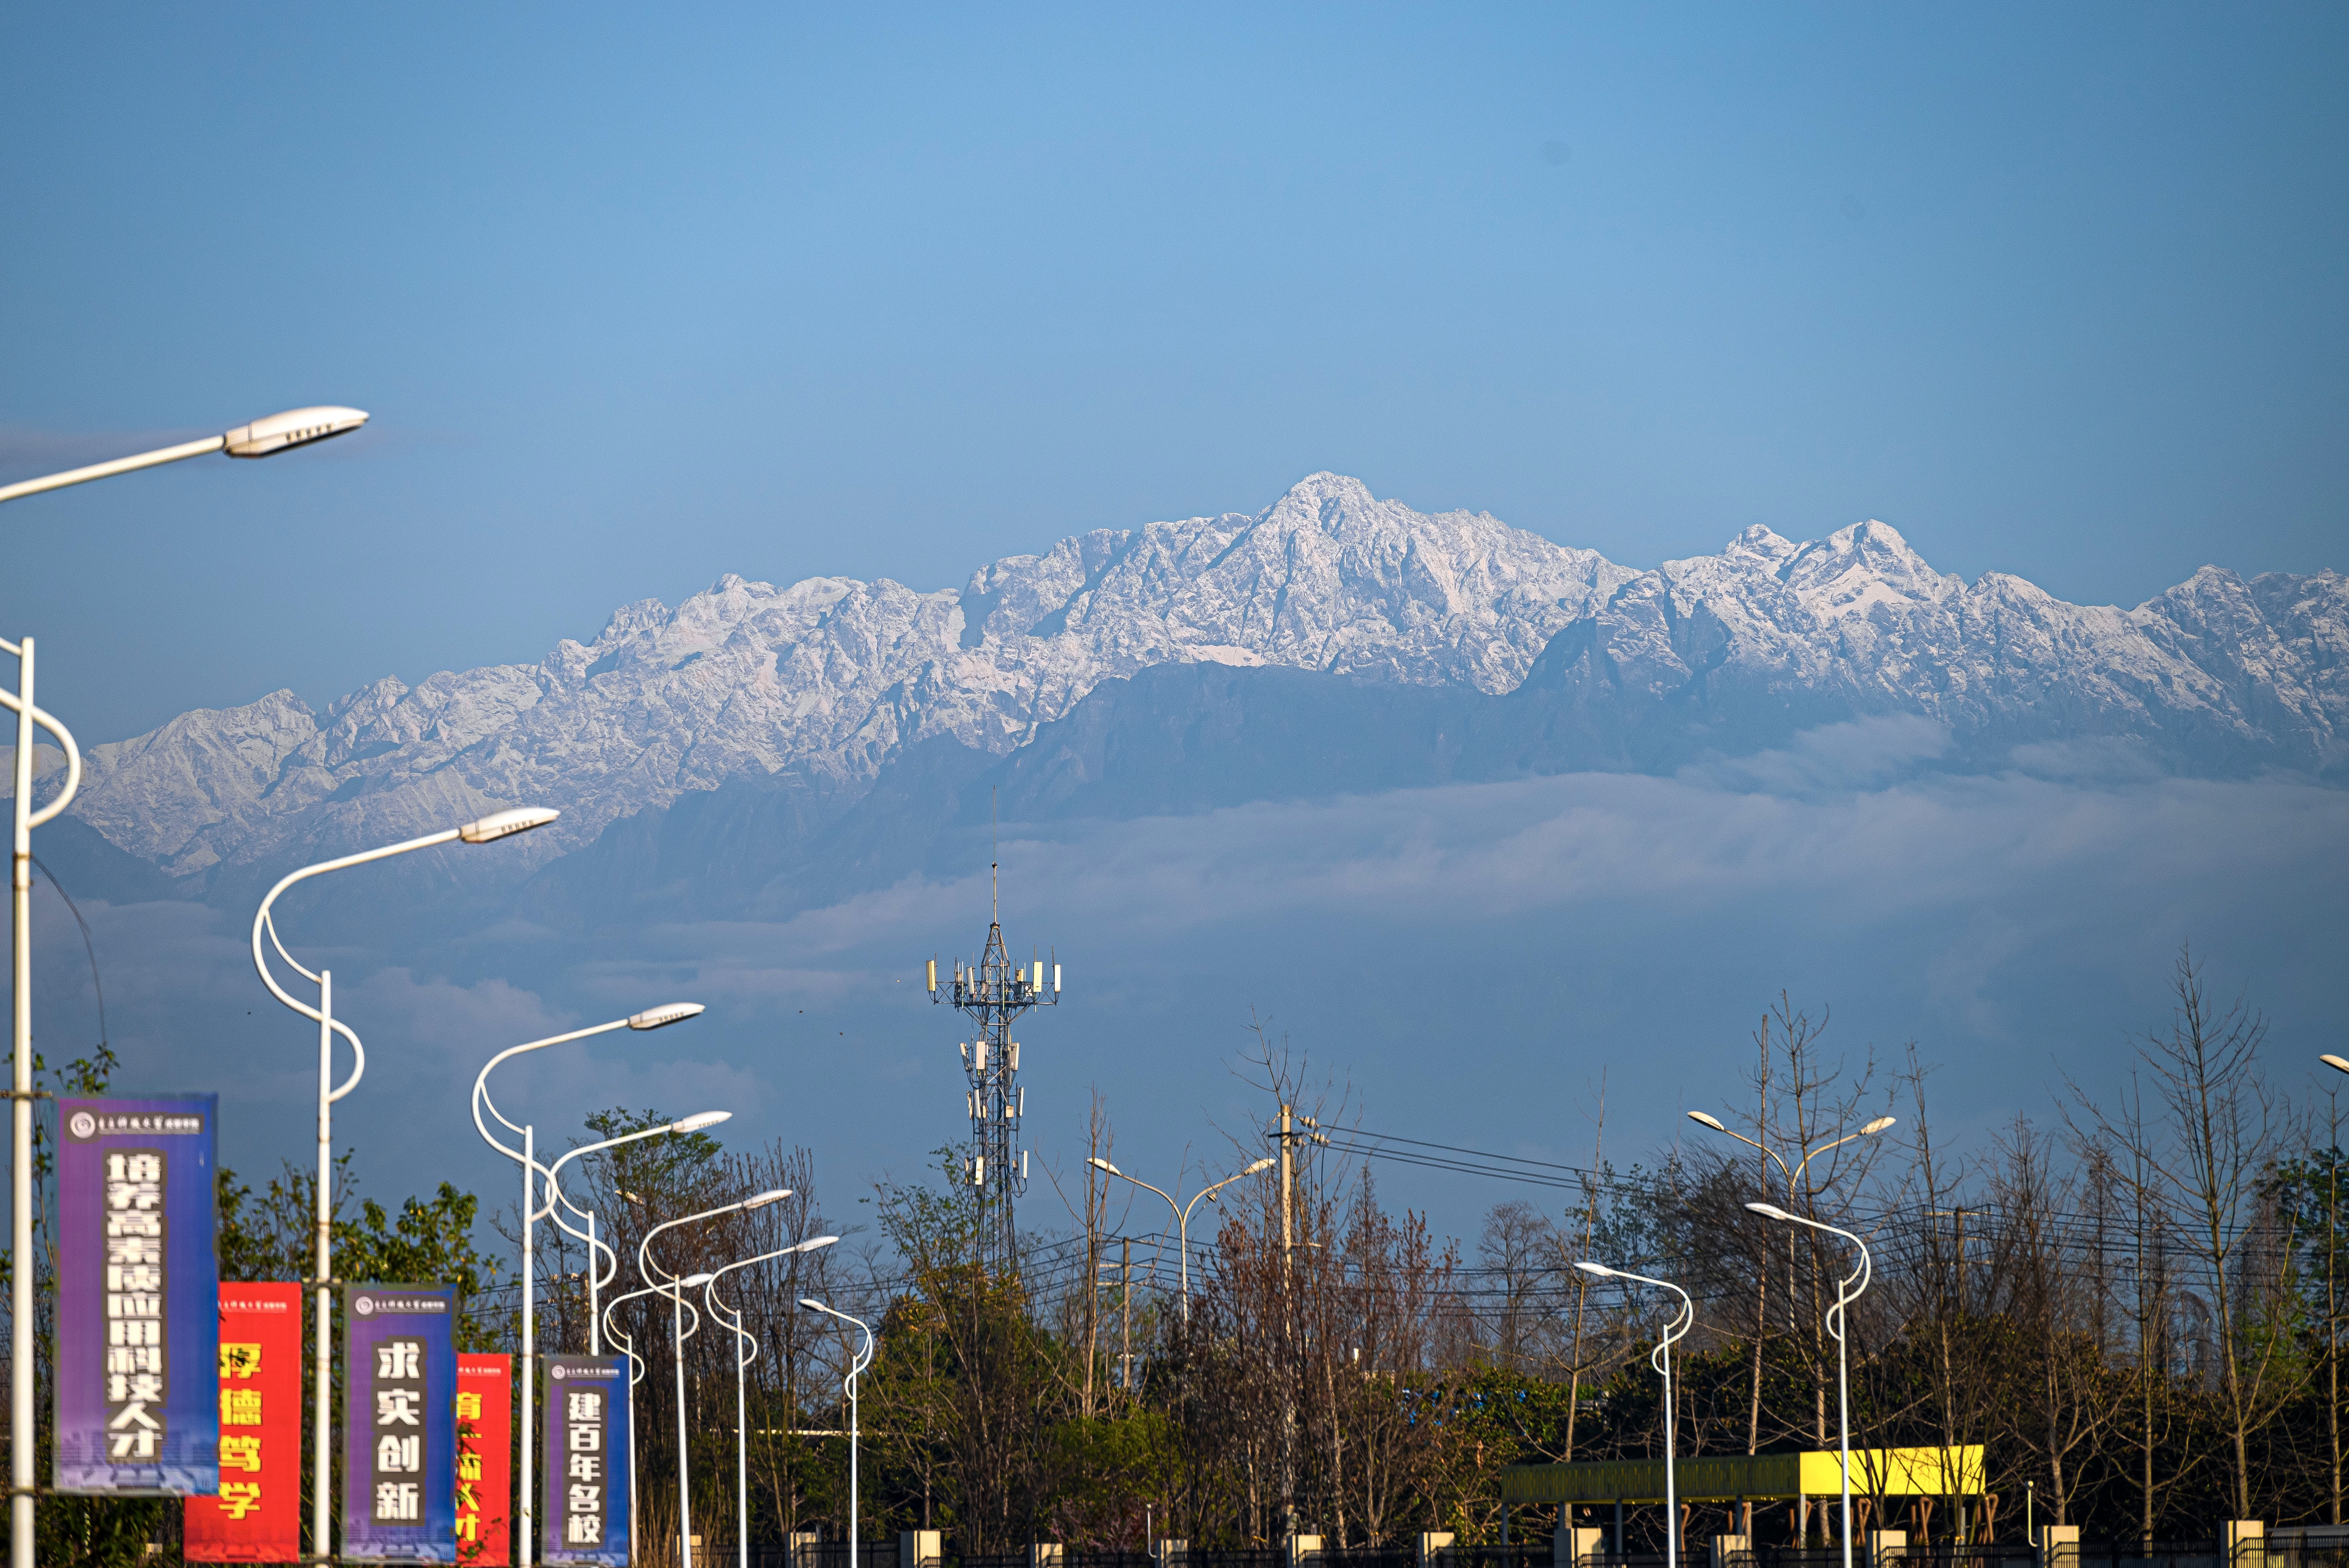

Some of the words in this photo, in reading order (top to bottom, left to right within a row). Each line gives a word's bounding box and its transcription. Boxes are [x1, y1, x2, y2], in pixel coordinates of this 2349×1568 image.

[107, 1153, 163, 1458] 培养高素质应用科技人才
[218, 1342, 262, 1520] 厚德笃学
[376, 1342, 421, 1520] 求实创新
[568, 1392, 602, 1543] 建百年名校
